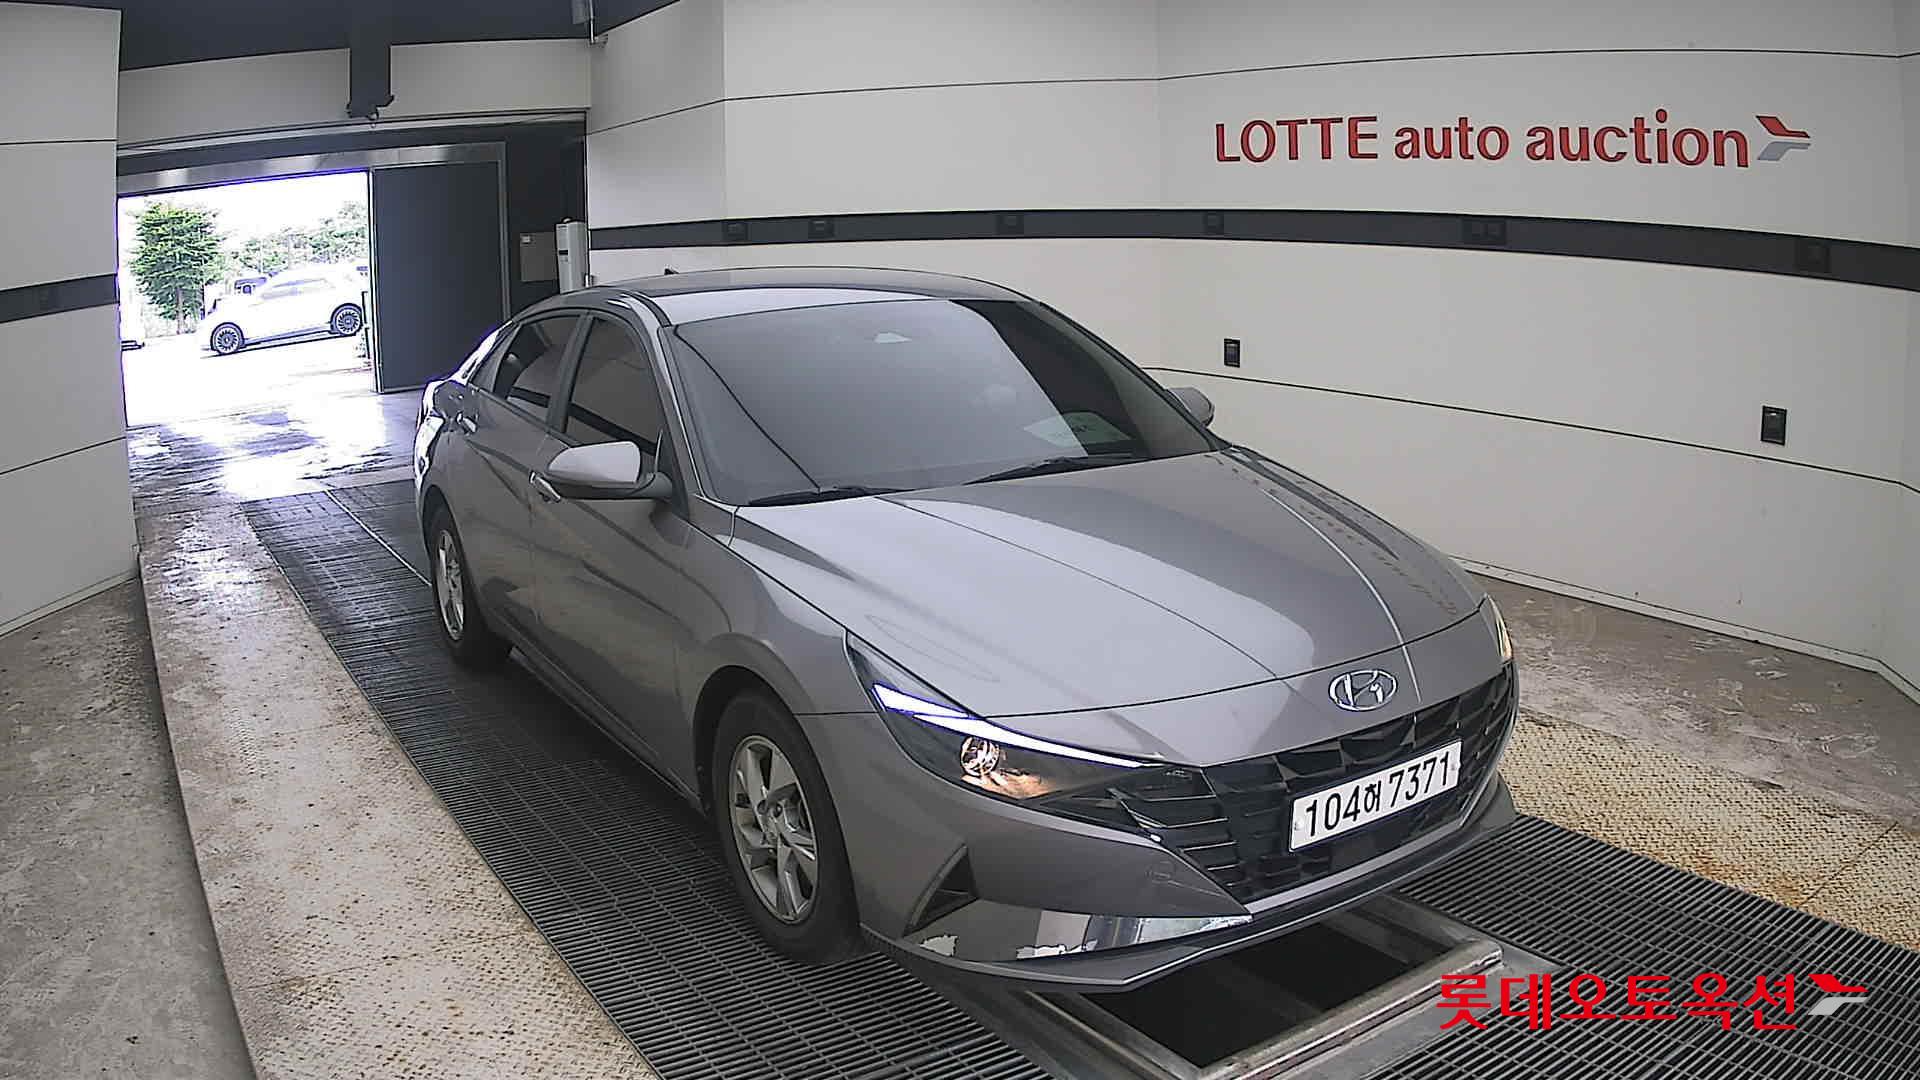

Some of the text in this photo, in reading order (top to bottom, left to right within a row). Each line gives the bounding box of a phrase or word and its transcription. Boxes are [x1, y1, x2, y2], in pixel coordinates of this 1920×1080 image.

[1215, 109, 1751, 168] LOTTE auto auction
